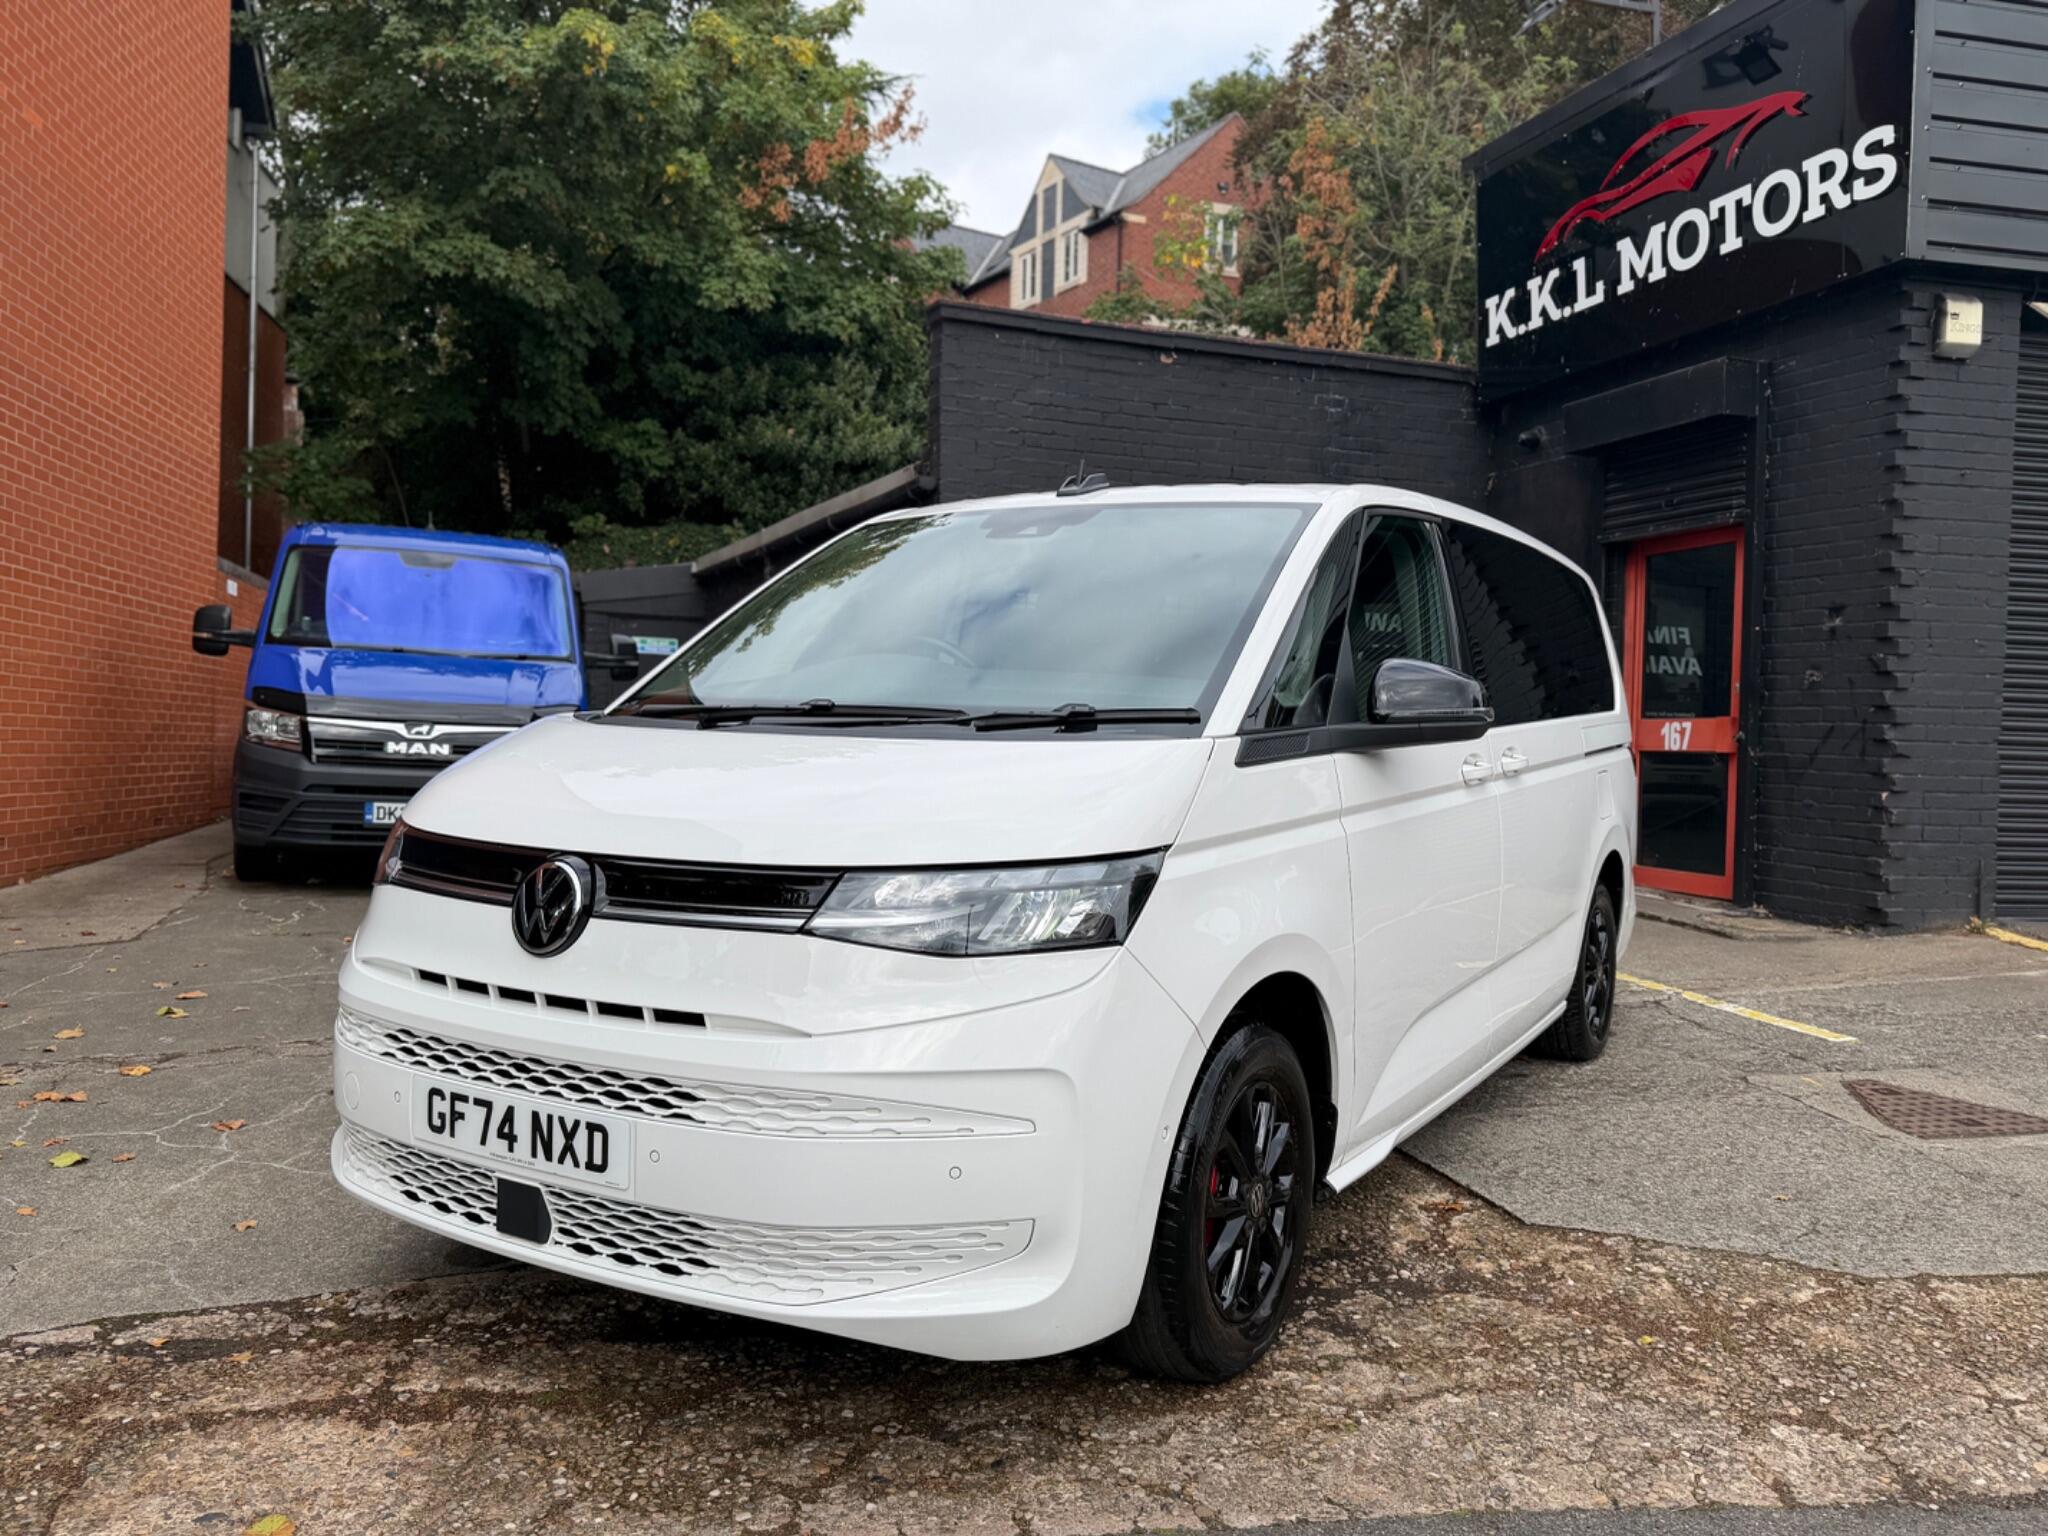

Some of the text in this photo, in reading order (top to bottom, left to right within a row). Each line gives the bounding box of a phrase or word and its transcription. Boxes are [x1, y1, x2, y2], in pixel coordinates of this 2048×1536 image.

[1485, 124, 1898, 347] K.K.L MOTORS
[386, 741, 450, 755] MAN
[1661, 721, 1692, 751] 167
[376, 806, 405, 820] DK
[428, 1087, 609, 1174] GF74 NXD
